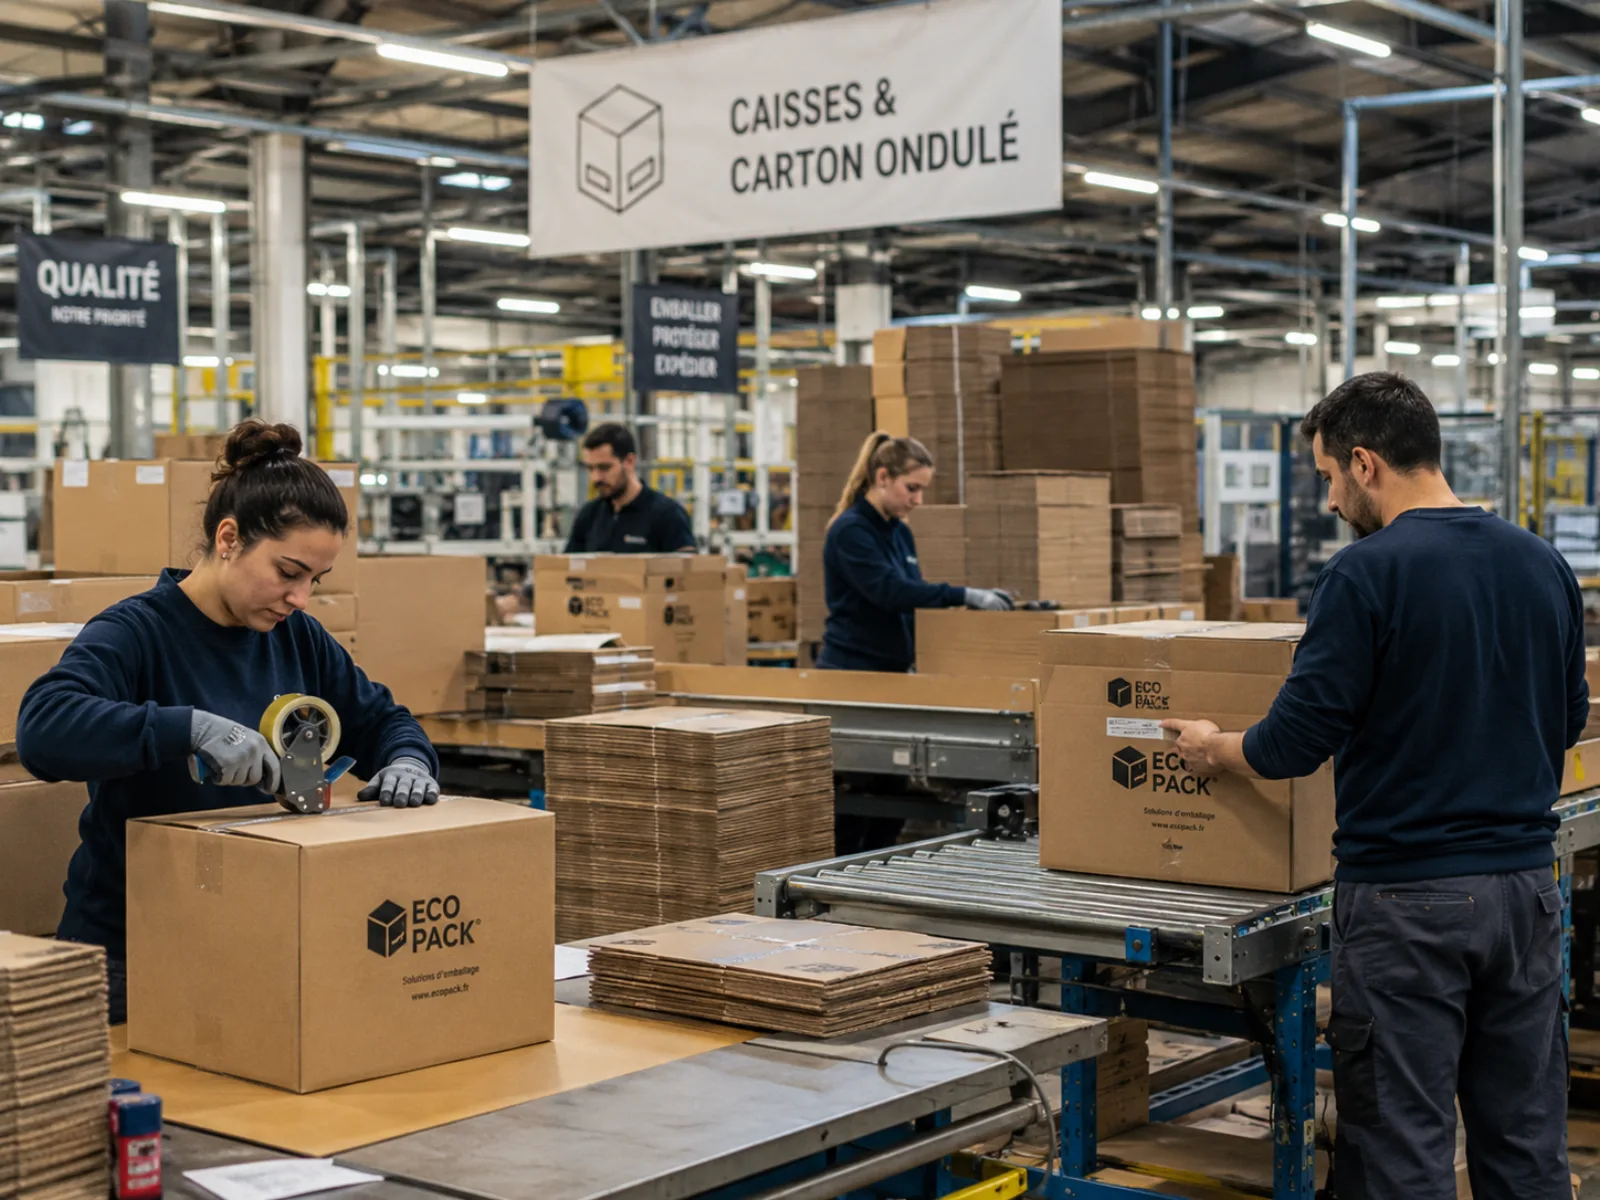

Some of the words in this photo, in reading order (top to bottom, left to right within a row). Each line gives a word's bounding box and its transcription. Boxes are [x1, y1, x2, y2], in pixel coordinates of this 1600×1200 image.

[731, 82, 863, 135] CAISSES
[874, 77, 897, 117] &
[731, 142, 863, 194] CARTON
[875, 109, 1019, 177] ONDULÉ
[37, 258, 161, 301] QUALITÉ
[51, 305, 92, 325] NOTRE
[1135, 681, 1162, 694] ECO
[412, 895, 460, 925] ECO
